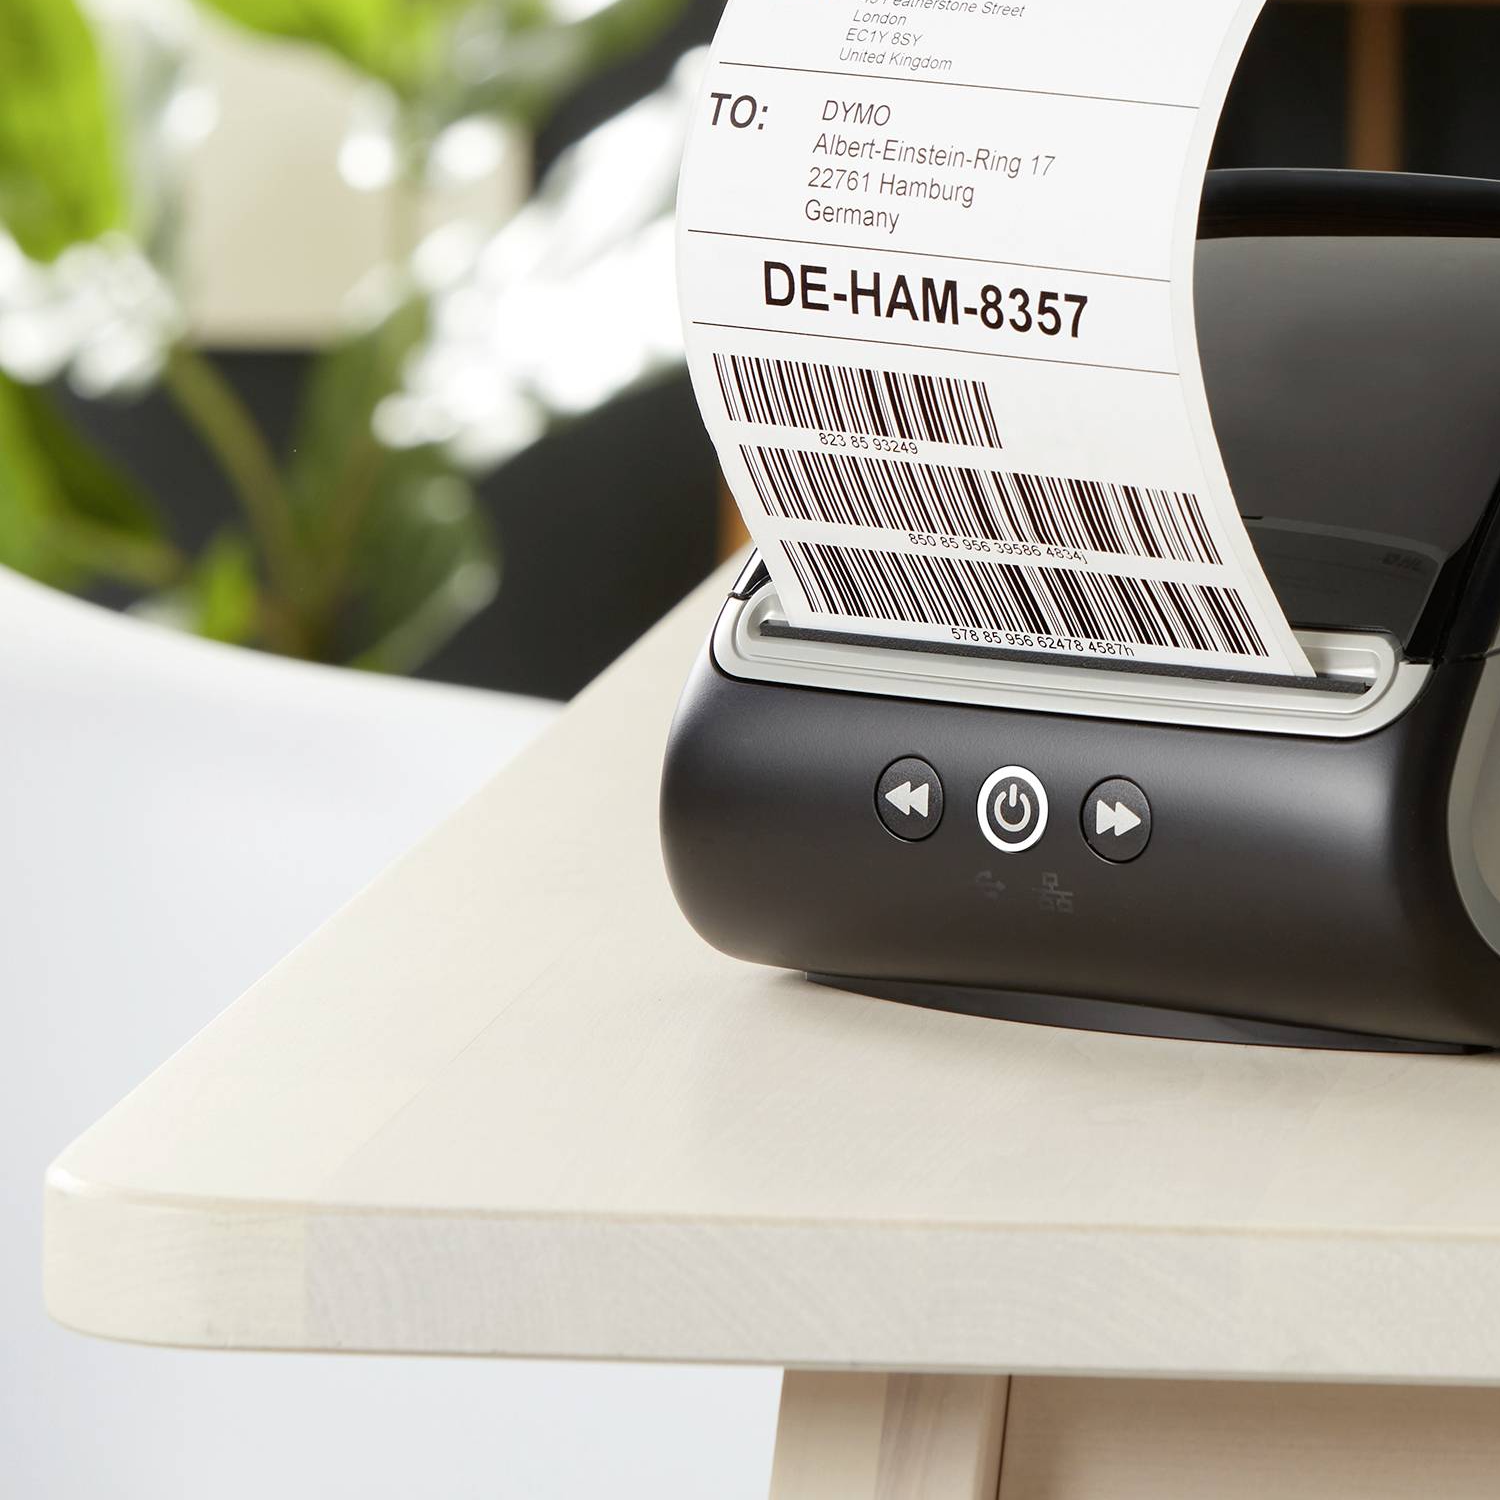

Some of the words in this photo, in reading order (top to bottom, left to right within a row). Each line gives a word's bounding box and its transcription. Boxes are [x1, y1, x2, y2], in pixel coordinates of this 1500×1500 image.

[853, 9, 907, 26] London
[981, 1, 1026, 17] Street
[845, 27, 889, 43] EC1Y
[890, 32, 924, 47] 8SY
[839, 47, 887, 65] United
[888, 52, 953, 71] Kingdom
[710, 92, 769, 130] TO:
[821, 99, 891, 126] DYMO
[812, 132, 1022, 179] Albert-Einstein-Ring
[1031, 155, 1056, 176] 17
[807, 166, 870, 192] 22761
[879, 172, 975, 208] Hamburg
[805, 198, 900, 234] Germany
[763, 260, 1089, 338] DE-HAM-8357
[818, 432, 847, 447] 823
[850, 435, 869, 449] 85
[872, 437, 918, 455] 93249
[908, 533, 937, 547] 850
[939, 536, 959, 550] 85
[962, 538, 991, 553] 956
[993, 542, 1042, 557] 39586
[1046, 546, 1088, 565] 4834j
[951, 627, 980, 642] 578
[982, 630, 1002, 644] 85
[1005, 632, 1034, 647] 956
[1037, 636, 1085, 652] 62478
[1088, 640, 1136, 657] 4587h
